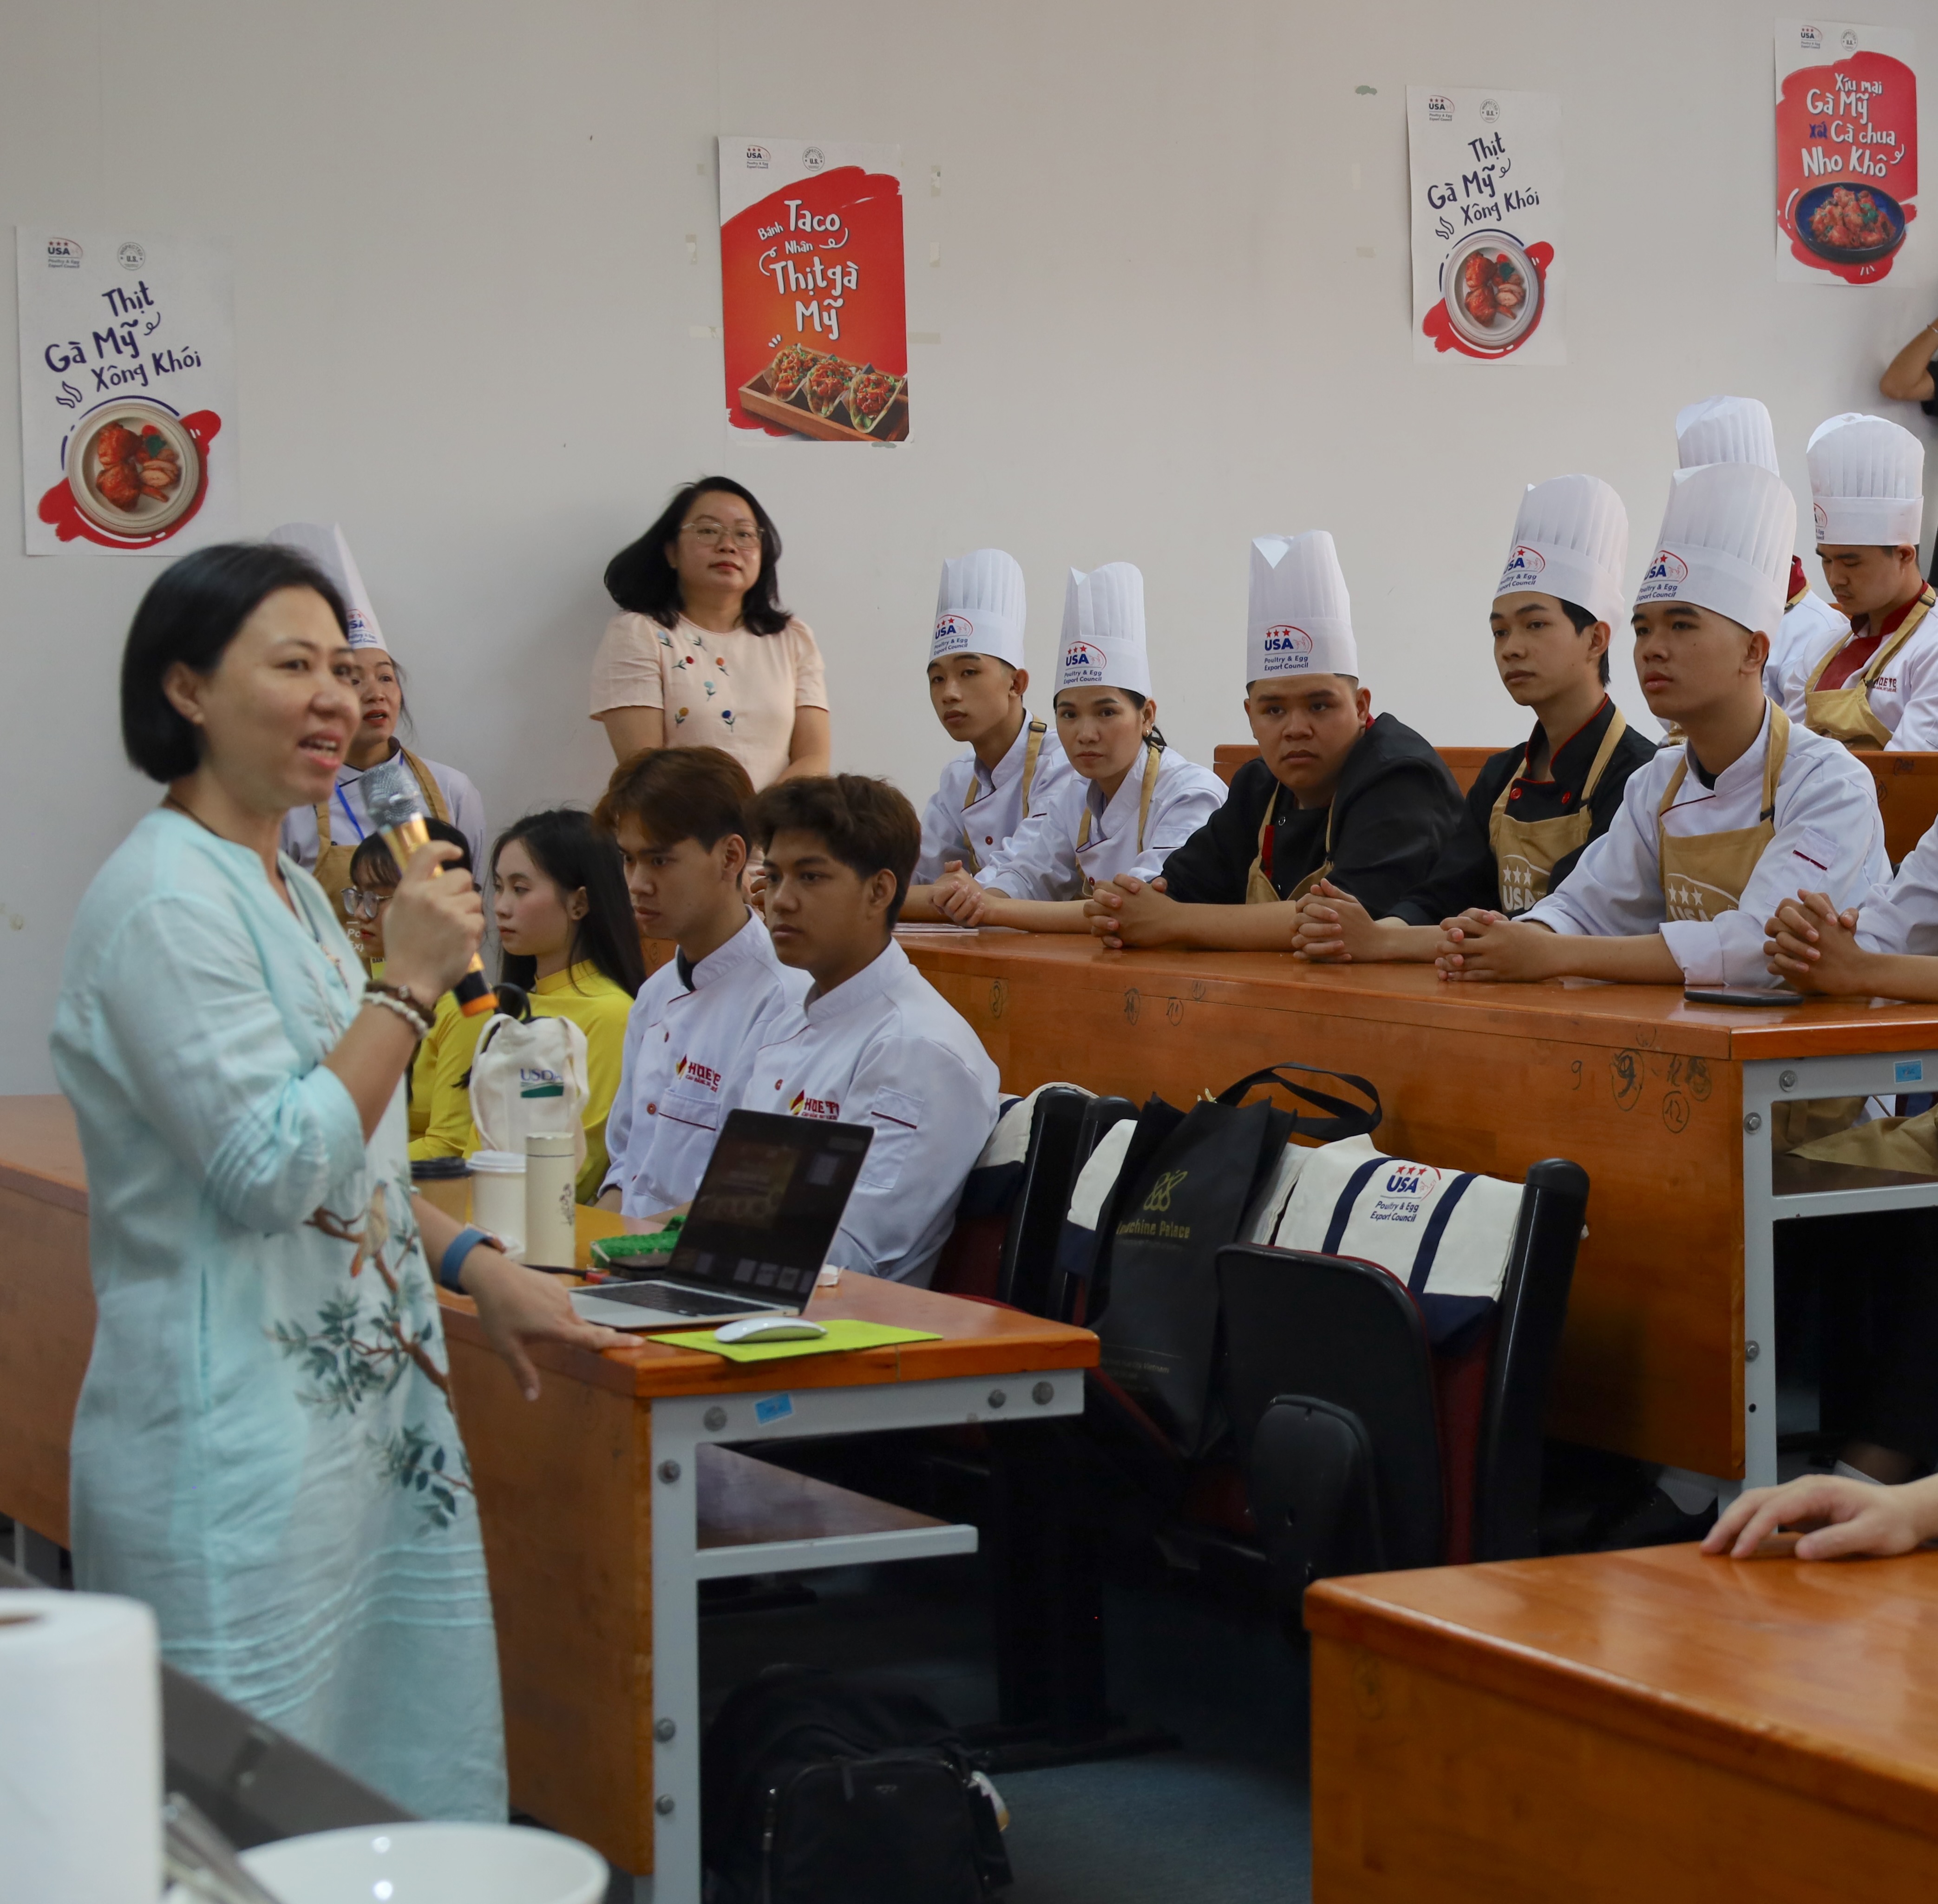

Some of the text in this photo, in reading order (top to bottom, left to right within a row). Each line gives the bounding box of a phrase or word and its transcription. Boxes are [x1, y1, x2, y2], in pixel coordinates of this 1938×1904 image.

[1835, 72, 1882, 96] Xíu mại
[1807, 89, 1869, 125] Gà Mỹ
[1831, 120, 1854, 143] Cà
[1859, 122, 1896, 146] chua
[1467, 131, 1506, 163] Thịt
[1801, 145, 1887, 177] Nho Khô
[1427, 164, 1496, 210] Gà Mỹ
[1460, 187, 1539, 226] Xông Khói
[758, 199, 841, 241] Bánh Taco
[48, 247, 70, 255] USA
[785, 240, 813, 255] Nhân
[101, 280, 154, 317] Thịt
[795, 298, 844, 340] Mỹ
[45, 319, 140, 373] Gà Mỹ
[91, 346, 201, 392] Xông Khói
[935, 625, 956, 639] USA
[1264, 638, 1294, 651] USA
[934, 640, 949, 650] Poultry
[934, 646, 947, 656] Export
[1066, 654, 1089, 666] USA
[1502, 885, 1537, 911] USA
[688, 1062, 721, 1087] HUEC
[1571, 1060, 1583, 1090] 9
[1386, 1175, 1420, 1194] USA
[1370, 1211, 1417, 1222] Export Council
[1375, 1201, 1399, 1212] Poultry
[1406, 1202, 1420, 1213] Egg
[1159, 1220, 1191, 1239] Palace
